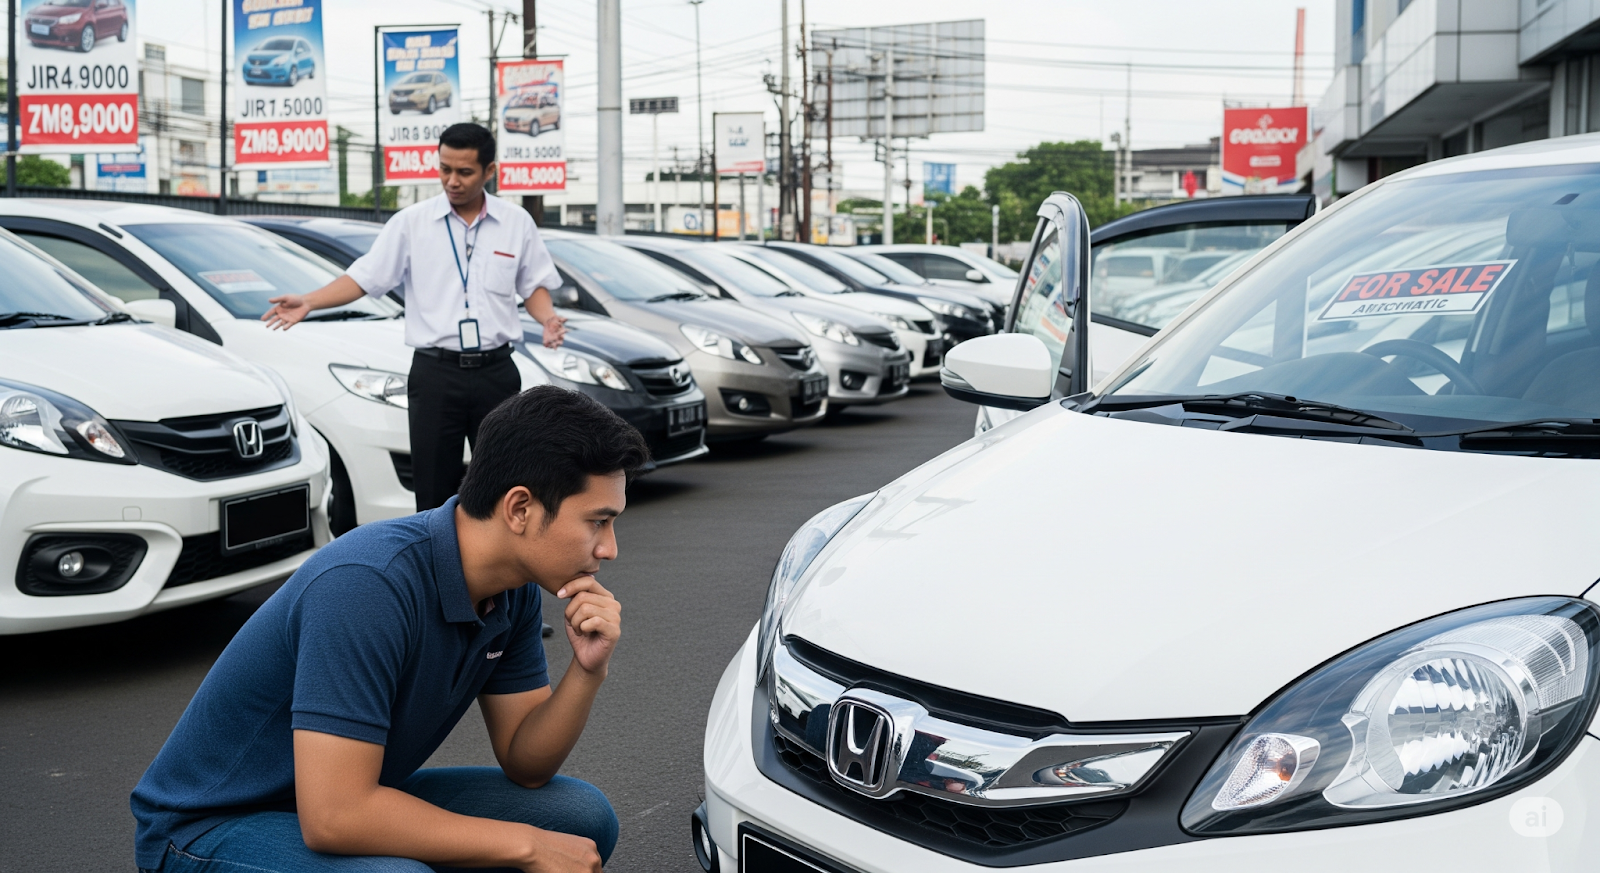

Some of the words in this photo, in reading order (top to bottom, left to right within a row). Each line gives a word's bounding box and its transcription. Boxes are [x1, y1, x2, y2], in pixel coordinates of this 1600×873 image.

[27, 103, 135, 140] ZM8,9000
[1339, 271, 1411, 301] FOR
[1411, 265, 1504, 296] SALE
